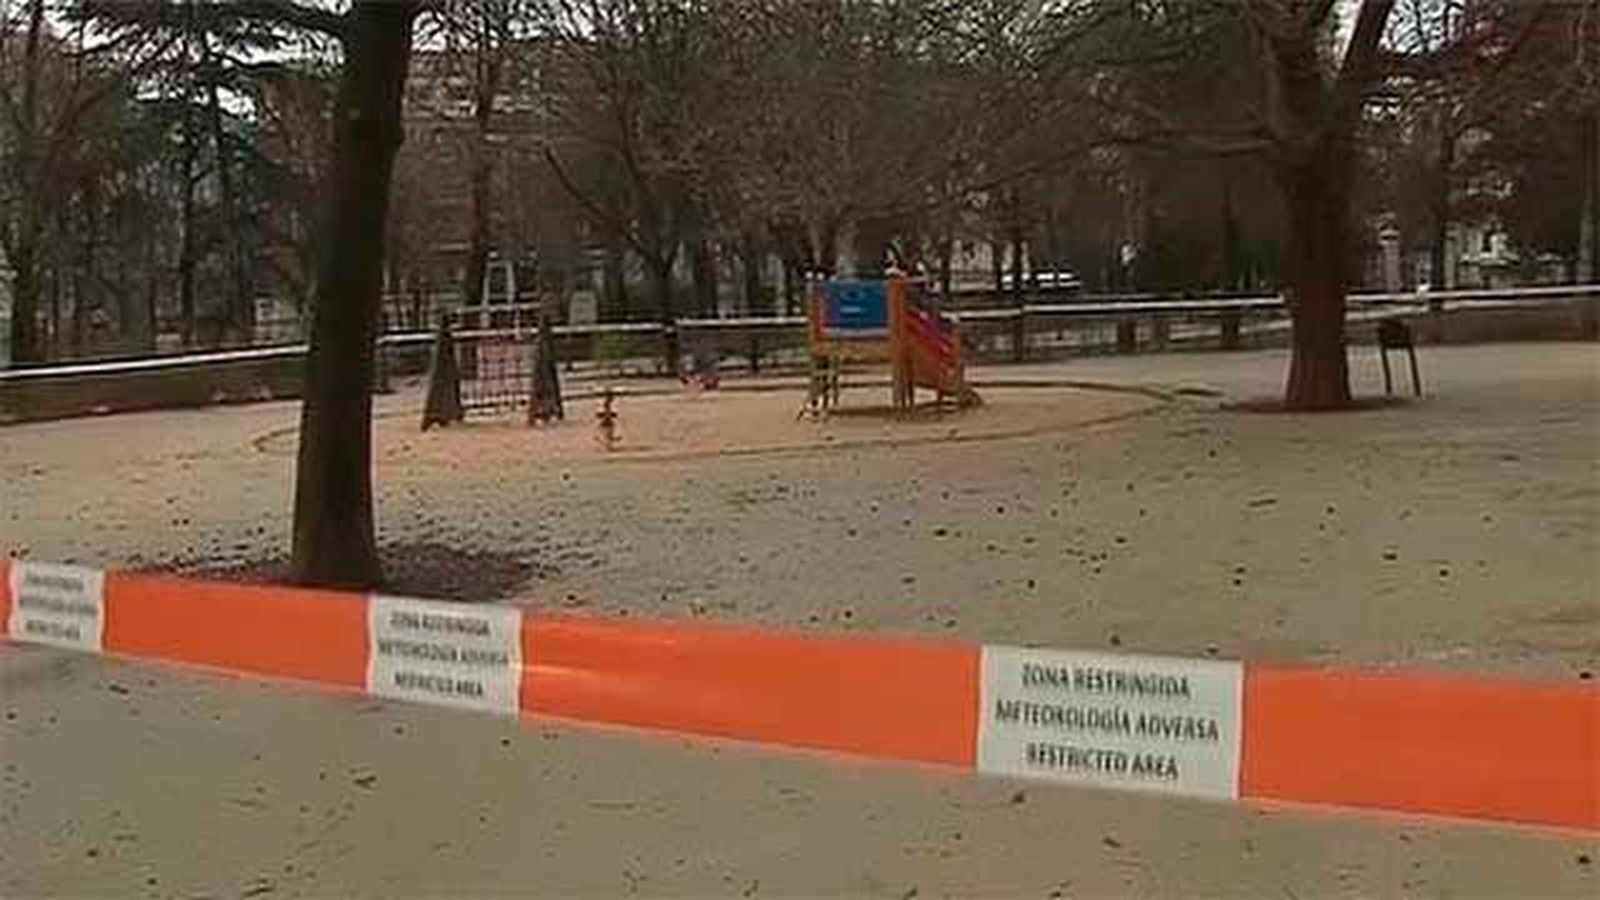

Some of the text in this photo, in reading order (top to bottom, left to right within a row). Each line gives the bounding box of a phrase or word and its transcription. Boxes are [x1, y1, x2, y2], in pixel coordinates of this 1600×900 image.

[1021, 663, 1191, 698] ZONA RESTRINGIDA
[996, 693, 1219, 741] METEOROLOGÍA ADVERSA
[1027, 742, 1178, 779] RESTRICTED AREA
